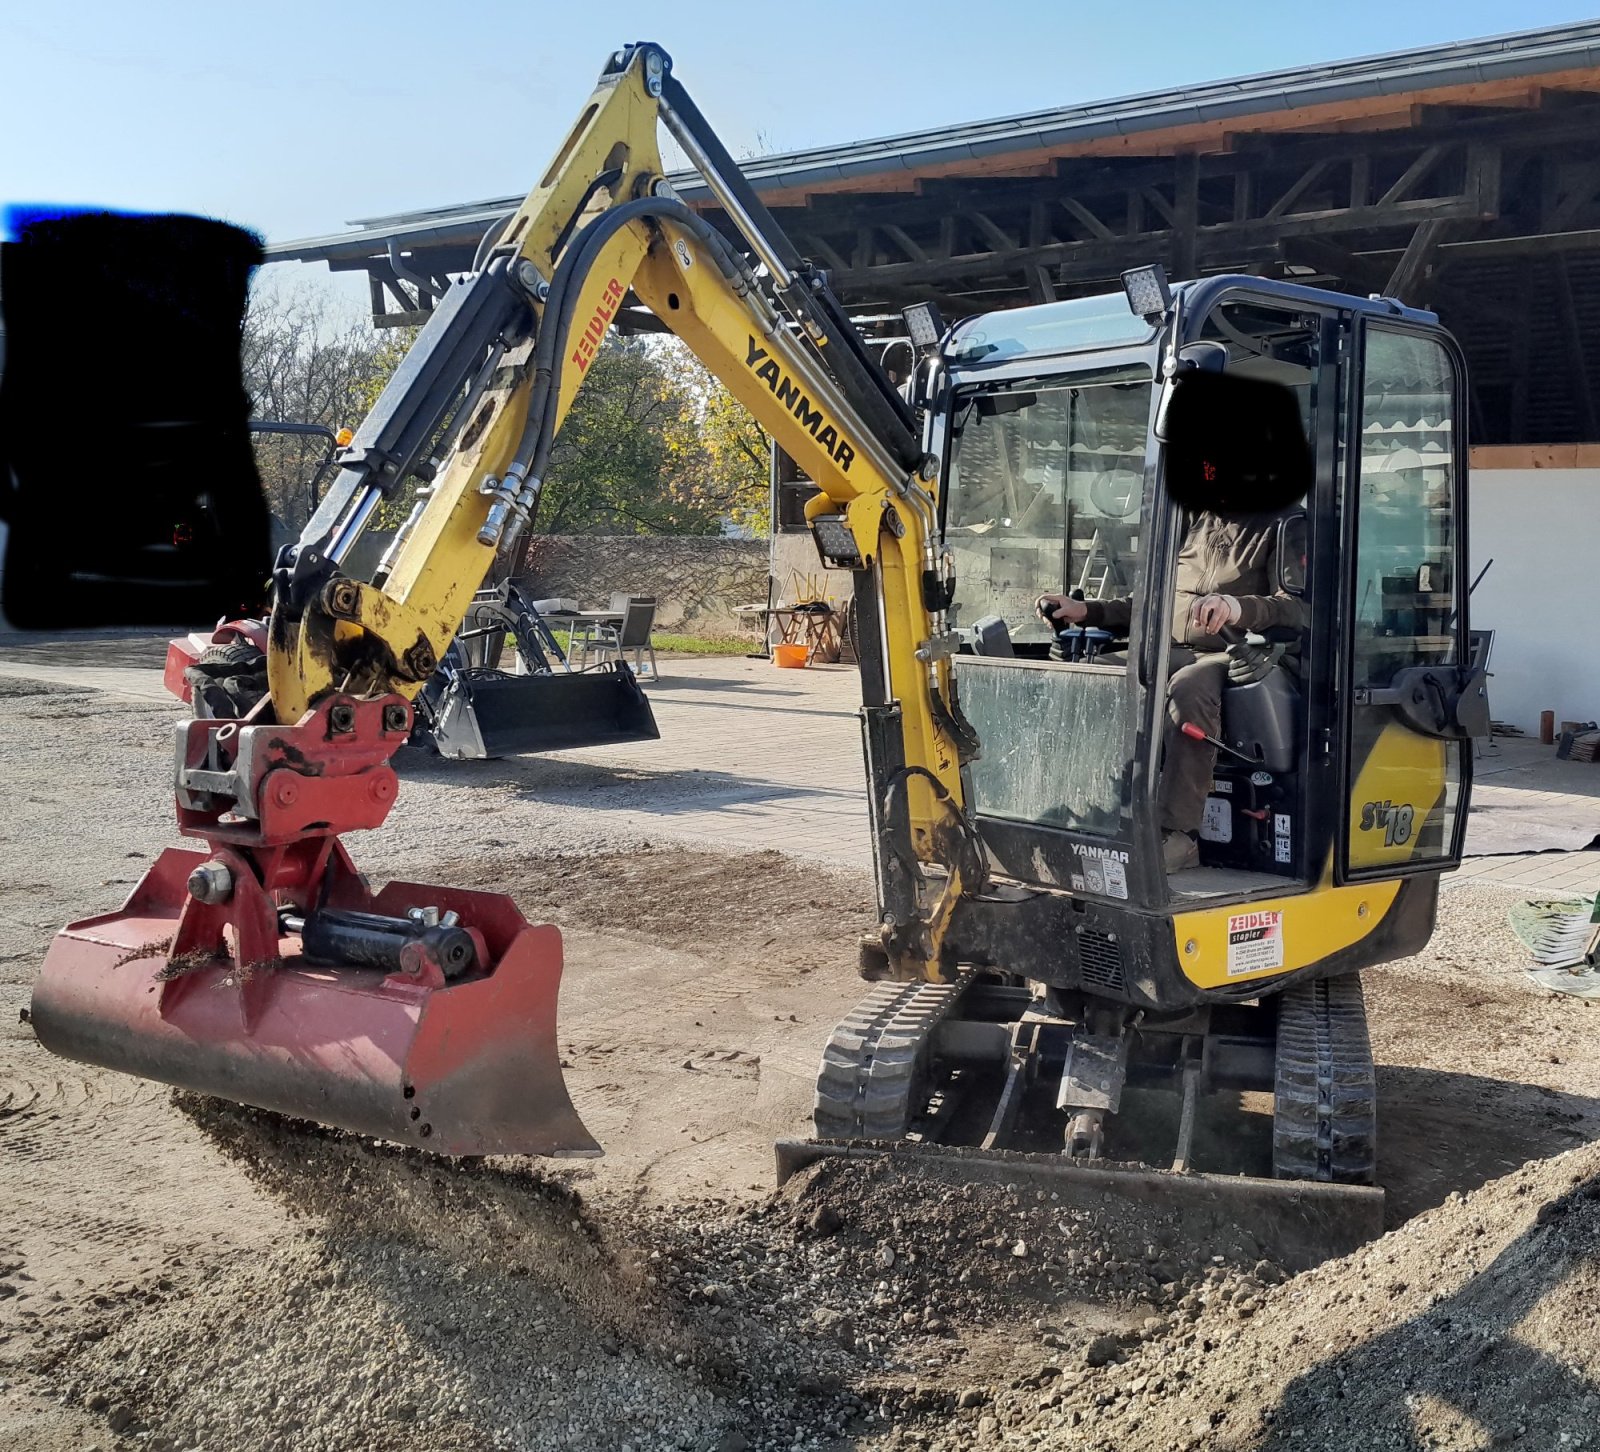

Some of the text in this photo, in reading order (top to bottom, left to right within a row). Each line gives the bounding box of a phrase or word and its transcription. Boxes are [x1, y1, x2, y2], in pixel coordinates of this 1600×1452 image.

[572, 278, 625, 373] ZEIDLER
[744, 334, 856, 473] YANMAR
[1070, 843, 1129, 864] YANMAR
[1231, 912, 1278, 931] ZEIDLER
[1232, 930, 1261, 942] stapler
